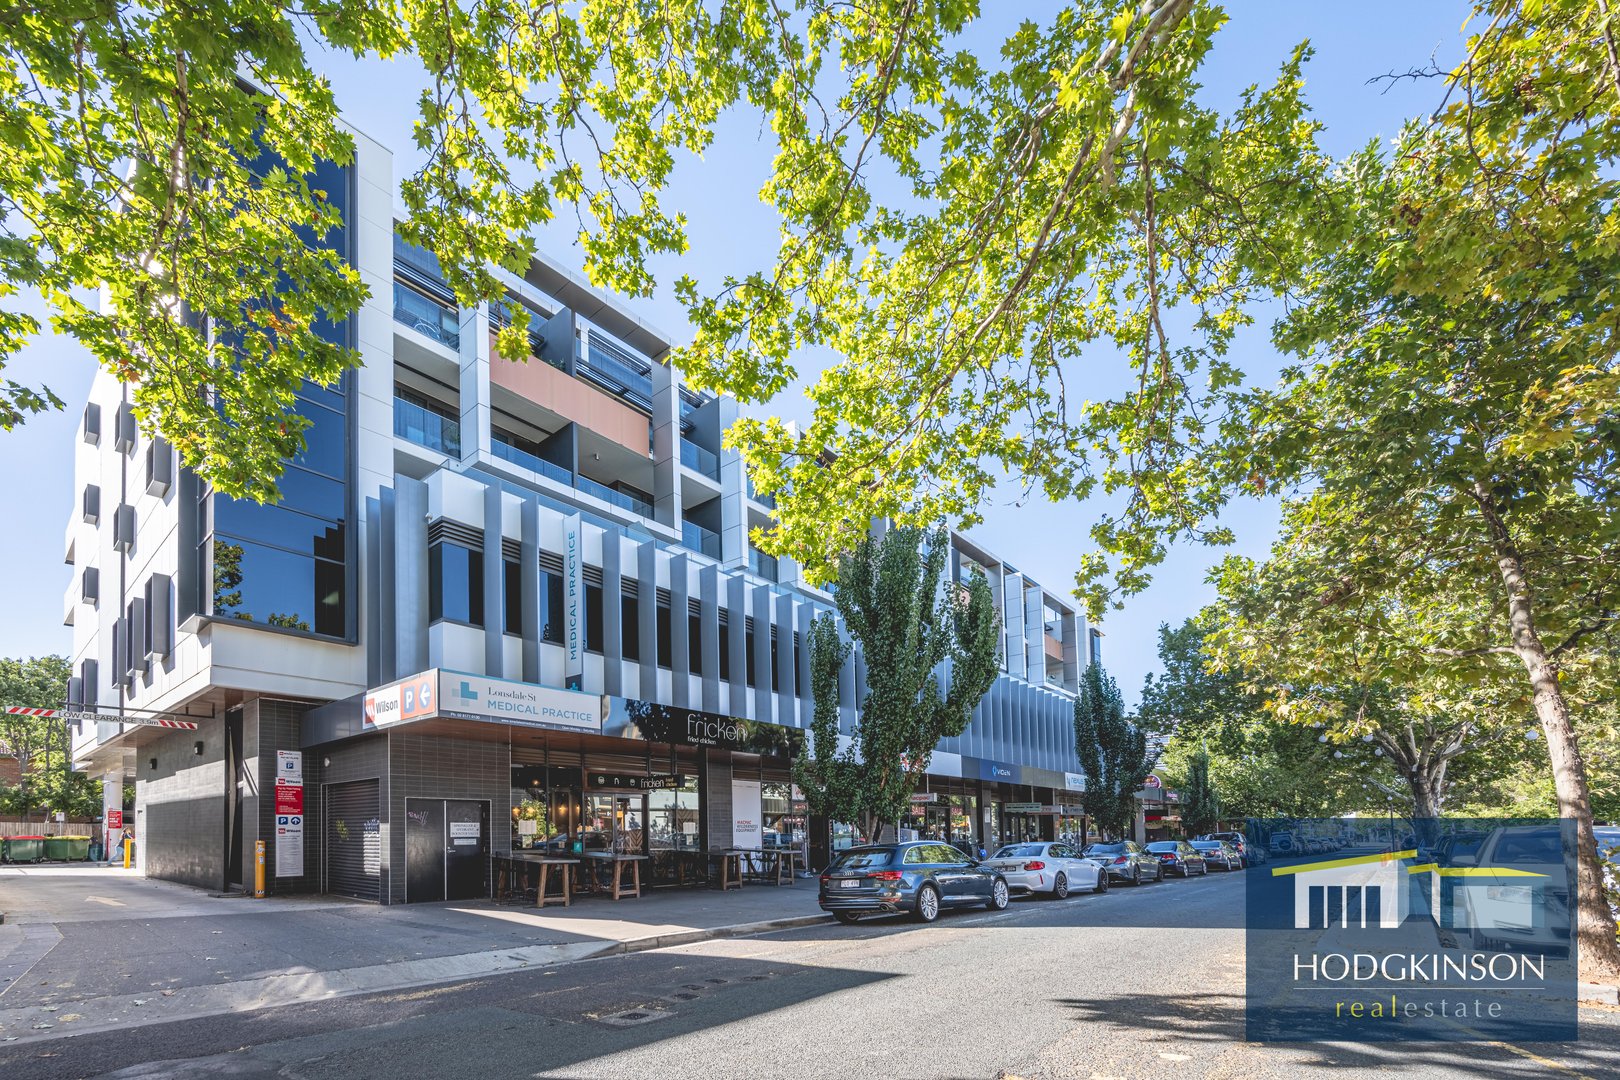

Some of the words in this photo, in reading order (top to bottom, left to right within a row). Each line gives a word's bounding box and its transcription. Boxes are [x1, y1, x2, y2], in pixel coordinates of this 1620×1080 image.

[568, 530, 576, 597] PRACTICE
[569, 600, 577, 661] MEDICAL
[405, 690, 414, 709] P
[488, 687, 527, 699] Lonsdale
[528, 693, 537, 702] St
[376, 699, 399, 714] Wilson
[487, 699, 539, 715] MEDICAL
[542, 707, 593, 722] PRACTICE
[58, 711, 80, 719] LOW
[82, 713, 137, 723] CLEARANCE
[139, 718, 159, 726] 3.9m
[687, 713, 747, 742] fricken
[700, 737, 717, 745] chicken
[640, 778, 665, 788] fricken
